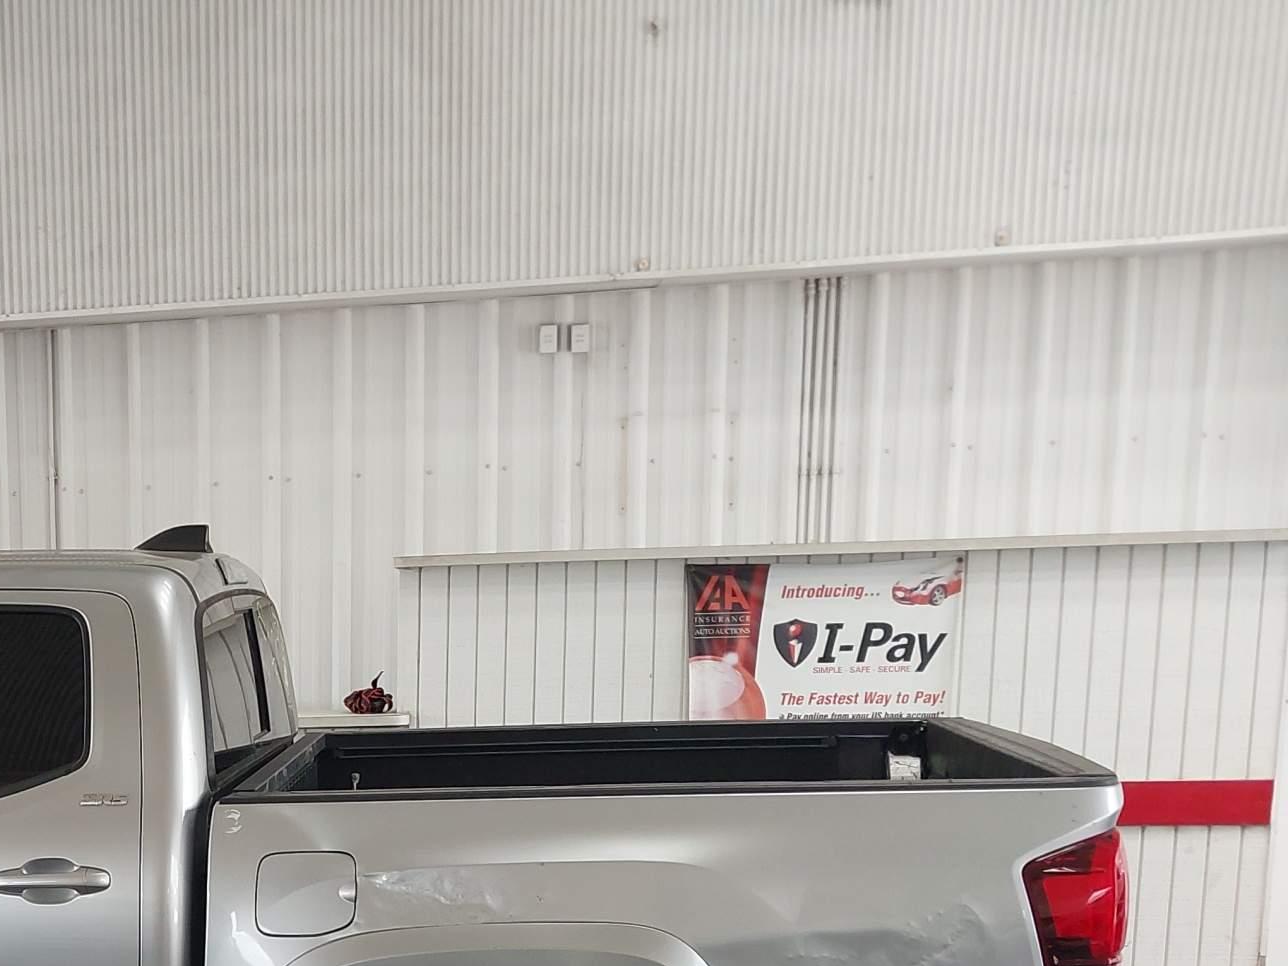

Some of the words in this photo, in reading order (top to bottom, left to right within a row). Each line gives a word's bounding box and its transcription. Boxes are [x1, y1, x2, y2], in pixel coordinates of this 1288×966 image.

[781, 584, 880, 599] Introducing...
[694, 615, 751, 624] INSURANCE
[694, 628, 714, 636] AUTO
[715, 627, 751, 635] AUCTIONS
[817, 622, 948, 672] I-Pay
[812, 666, 842, 674] SIMPLE
[878, 665, 910, 673] SECURE
[781, 692, 804, 705] The
[808, 692, 859, 705] Fastest
[864, 691, 892, 707] Way
[896, 691, 910, 704] to
[914, 690, 946, 706] Pay!
